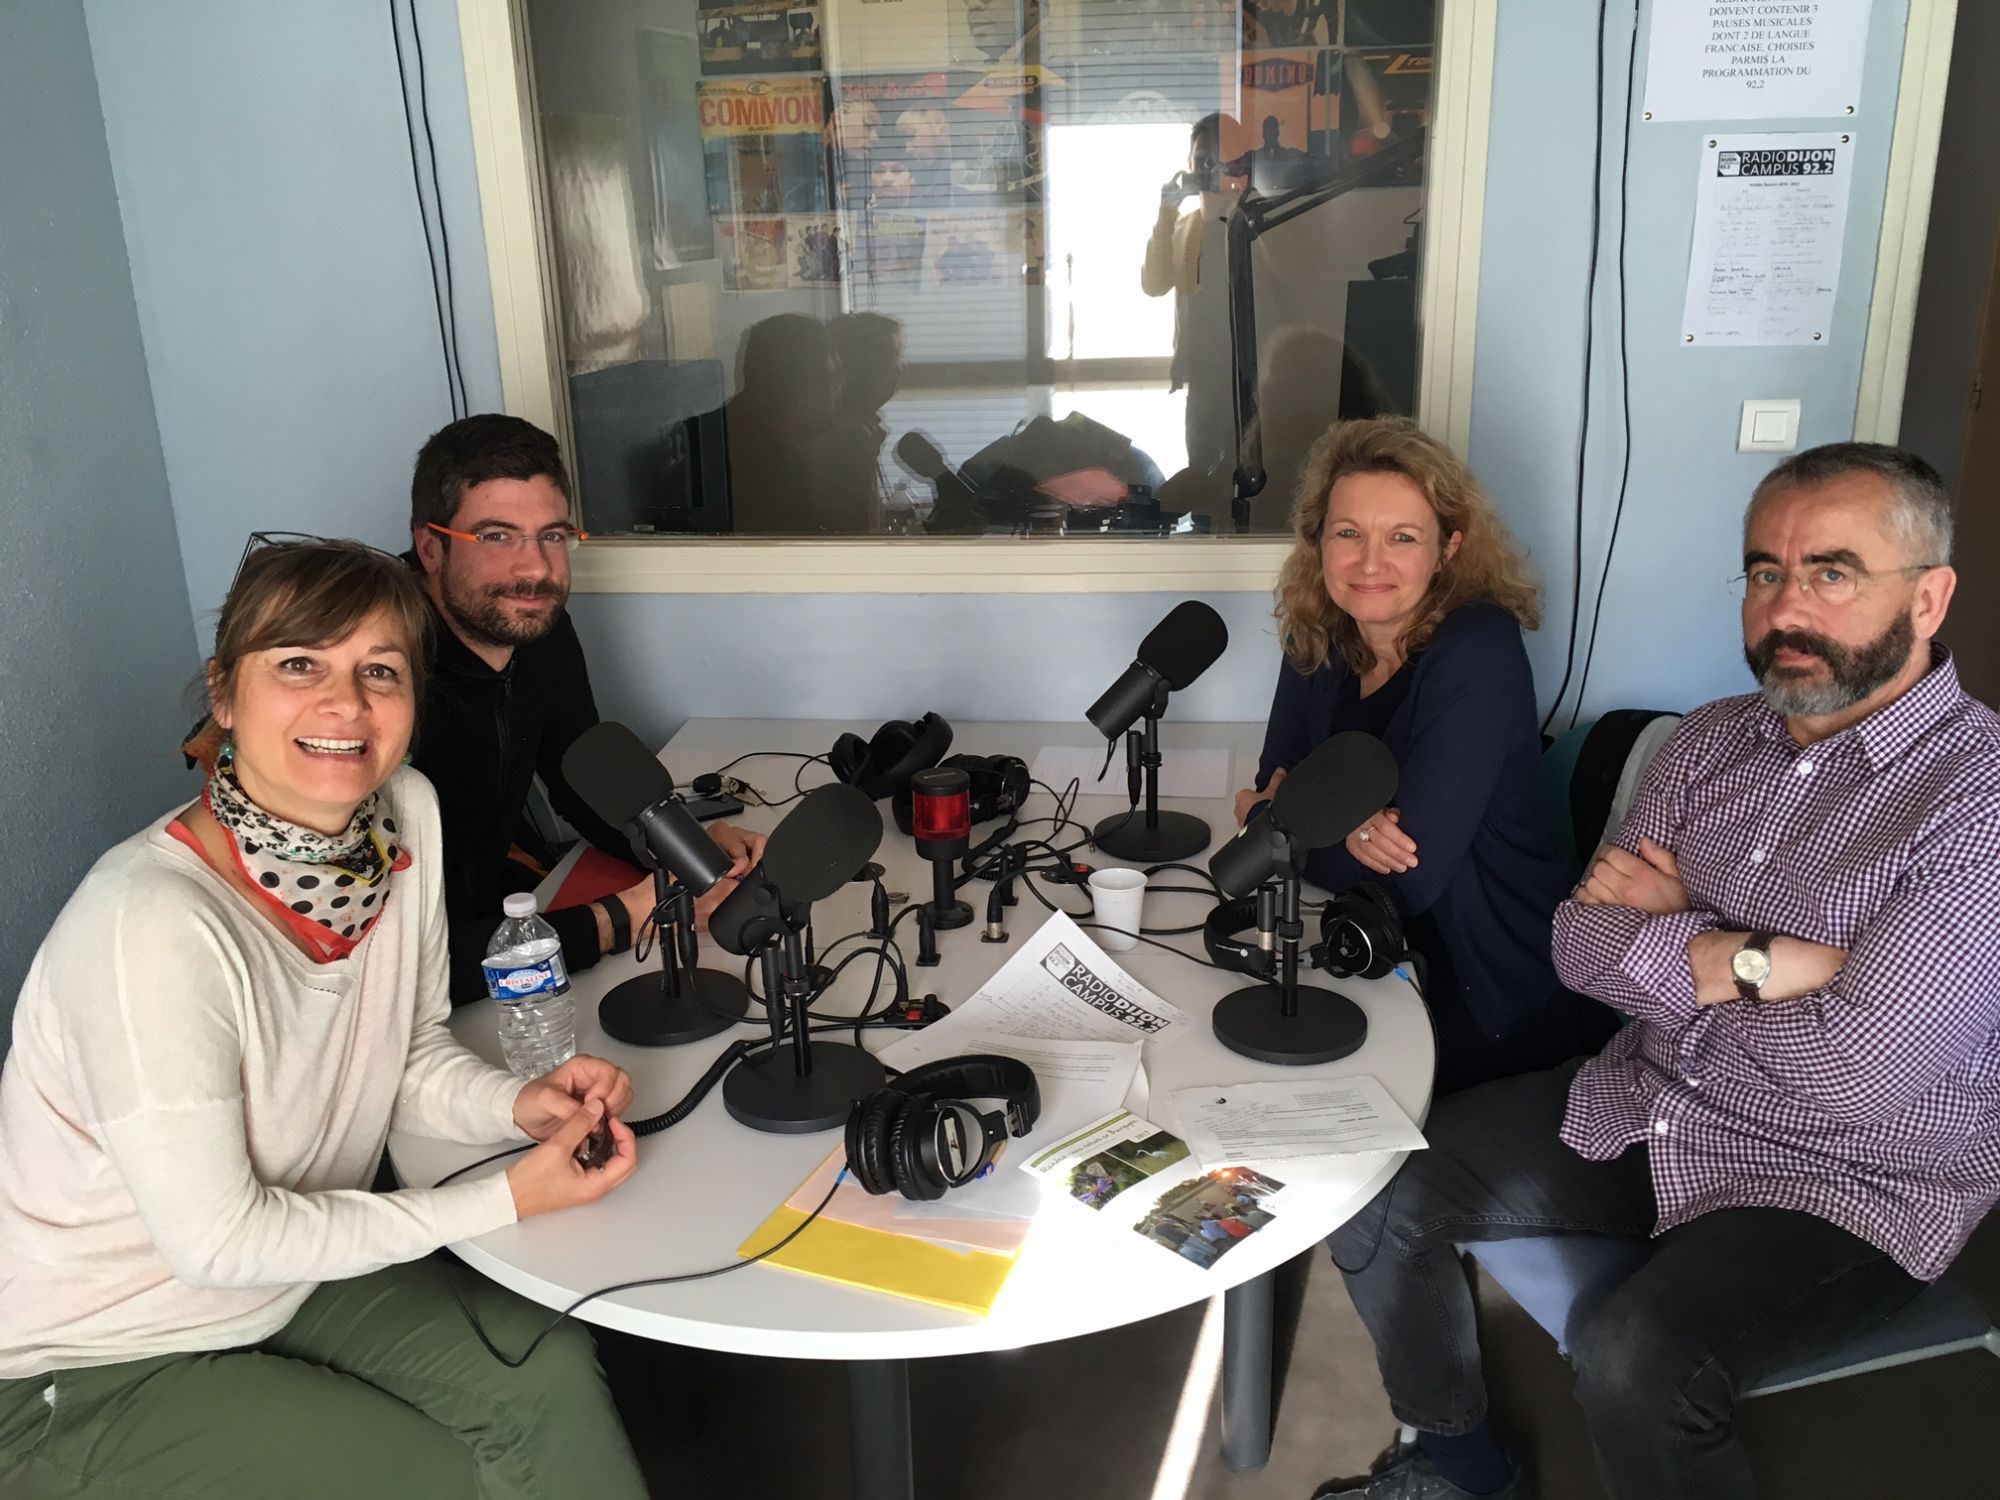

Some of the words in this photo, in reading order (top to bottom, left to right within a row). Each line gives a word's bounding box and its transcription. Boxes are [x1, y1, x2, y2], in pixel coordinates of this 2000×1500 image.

[1709, 6, 1755, 16] DOIVENT
[1757, 4, 1811, 15] CONTENIR
[1812, 4, 1819, 13] 3
[1712, 18, 1751, 28] PAUSES
[1753, 17, 1813, 27] MUSICALES
[1712, 31, 1741, 41] DONT
[1743, 31, 1749, 40] 2
[1751, 30, 1765, 40] DE
[1767, 29, 1811, 39] LANGUE
[1767, 41, 1815, 52] CHOISIES
[1731, 55, 1769, 65] PARMIS
[1772, 55, 1785, 64] LA
[1243, 64, 1307, 85] DOMINO
[1702, 66, 1794, 78] PROGRAMMATION
[1796, 66, 1812, 76] DU
[700, 95, 821, 127] COMMON
[1741, 163, 1800, 176] CAMPUS
[1802, 162, 1833, 175] 92.2
[500, 972, 549, 986] CRISTALINE
[1063, 975, 1124, 1018] CAMPUS
[1122, 1015, 1159, 1033] 92.2
